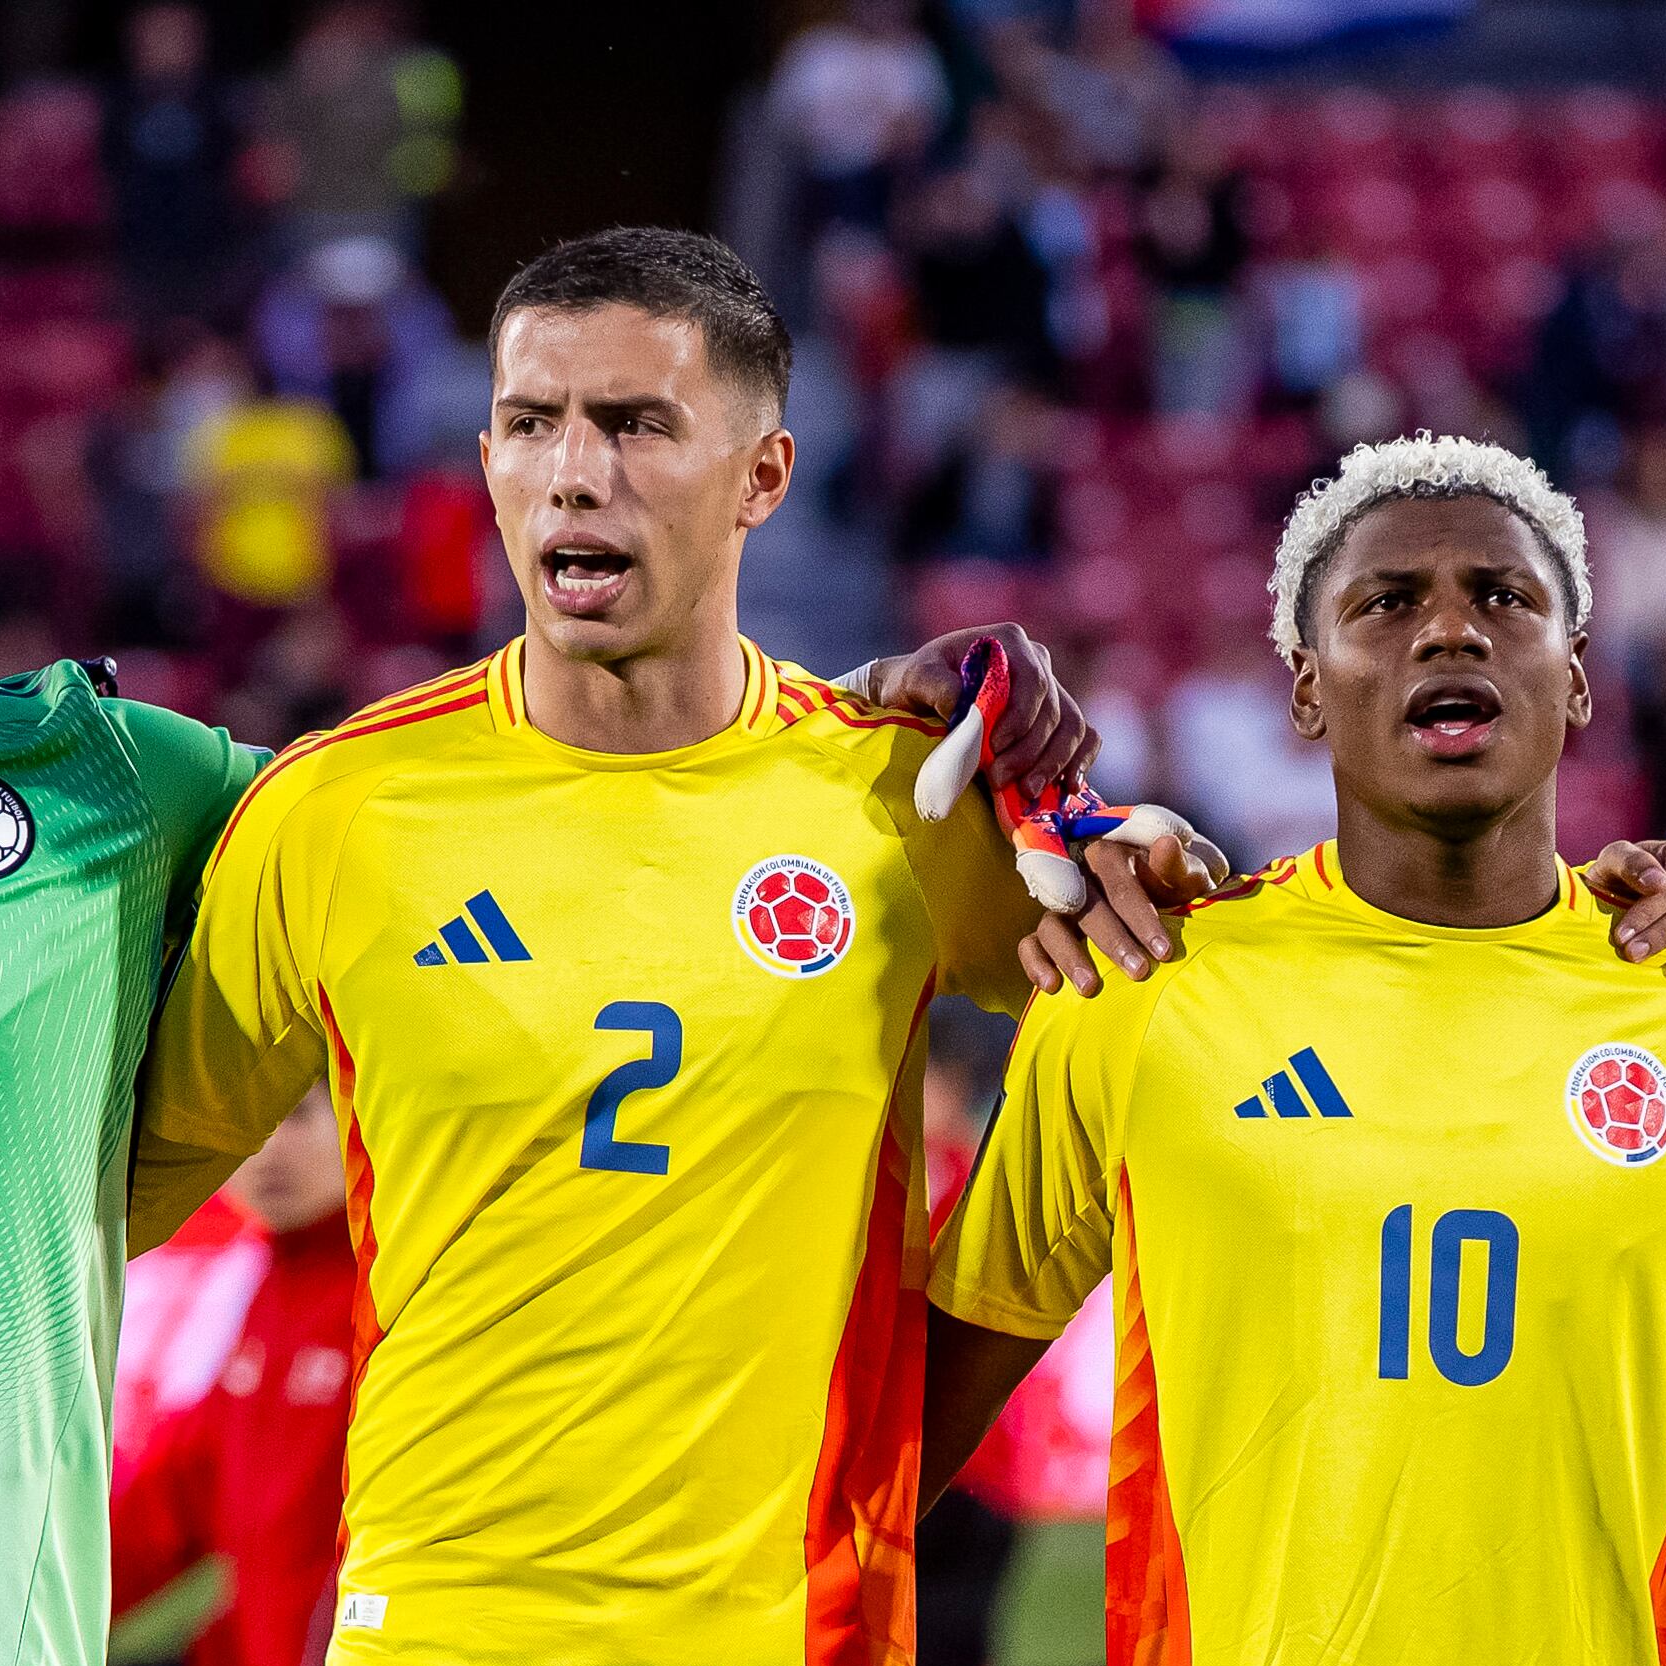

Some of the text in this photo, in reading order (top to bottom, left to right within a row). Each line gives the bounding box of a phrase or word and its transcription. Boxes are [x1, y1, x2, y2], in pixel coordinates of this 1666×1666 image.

[765, 859, 821, 875] COLOMBIANA
[822, 872, 833, 883] DE
[579, 1001, 683, 1175] 2
[1653, 1065, 1663, 1077] DE
[1378, 1203, 1520, 1387] 10
